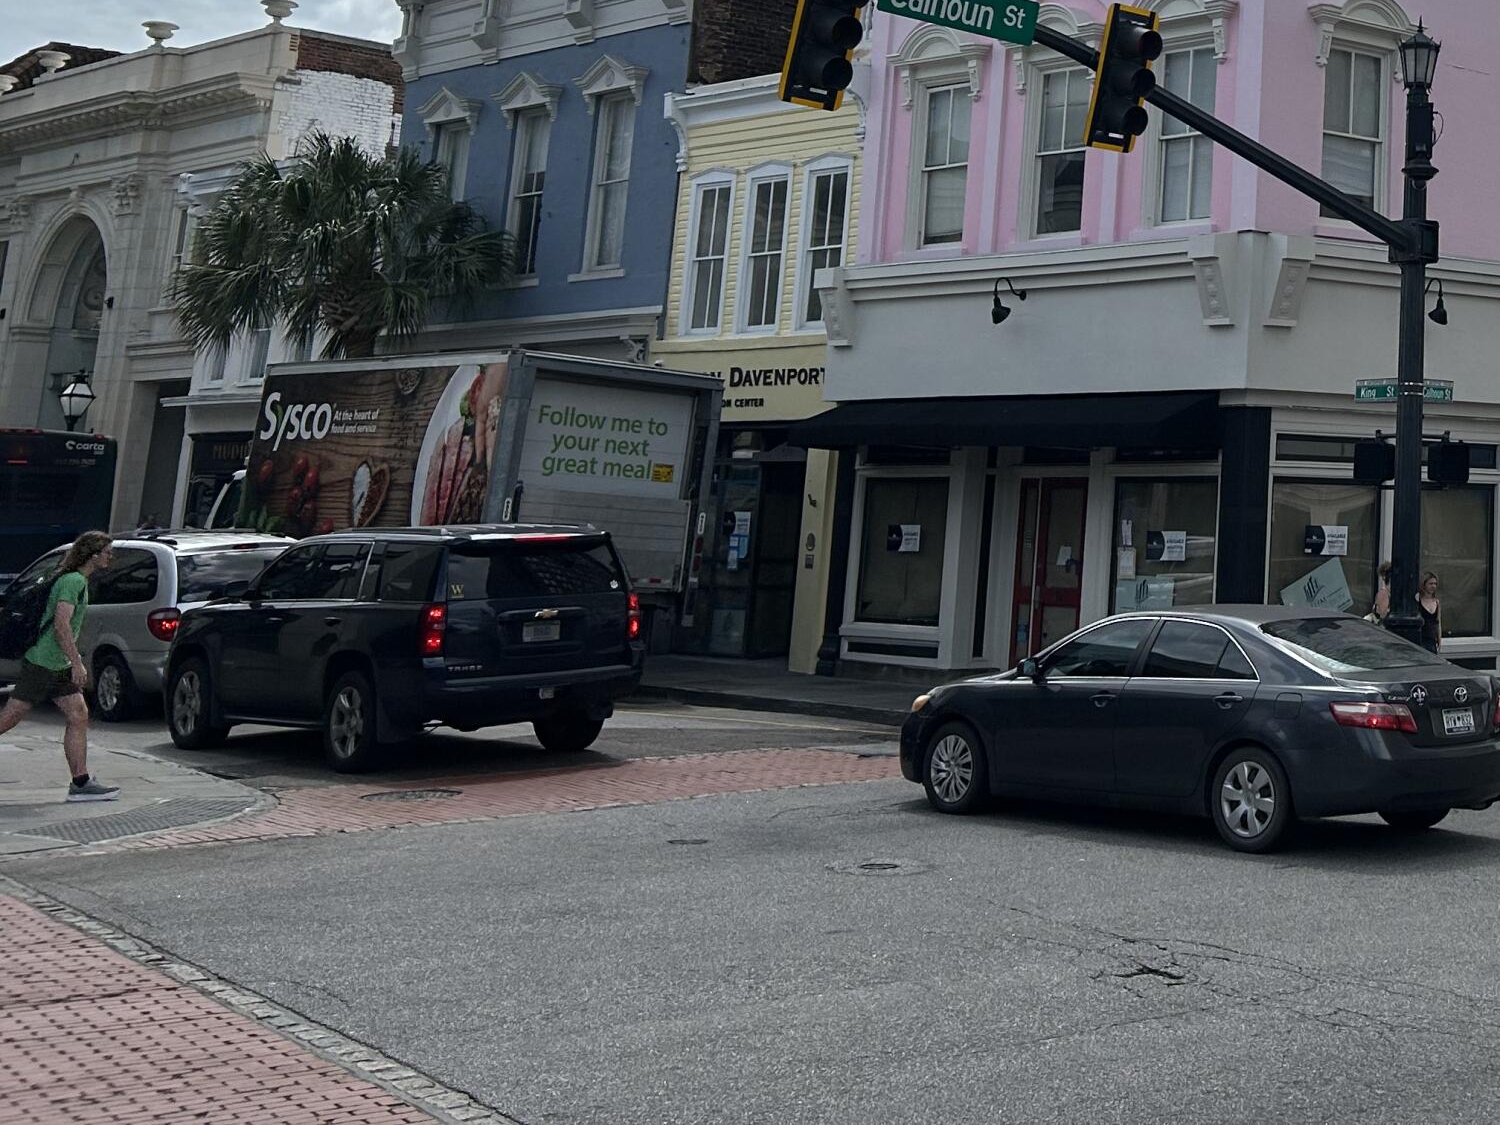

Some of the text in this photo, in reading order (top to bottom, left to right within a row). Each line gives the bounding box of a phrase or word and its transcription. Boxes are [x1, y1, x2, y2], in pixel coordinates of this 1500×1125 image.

[1003, 4, 1026, 29] St
[1360, 386, 1395, 399] King St
[1444, 388, 1452, 401] St
[735, 397, 764, 408] CENTER
[333, 408, 380, 421] At the heart of
[538, 404, 669, 436] Follow me to
[331, 423, 377, 434] food and service
[75, 442, 105, 451] carta
[551, 433, 650, 457] your next
[542, 456, 598, 477] great
[603, 459, 652, 479] meal
